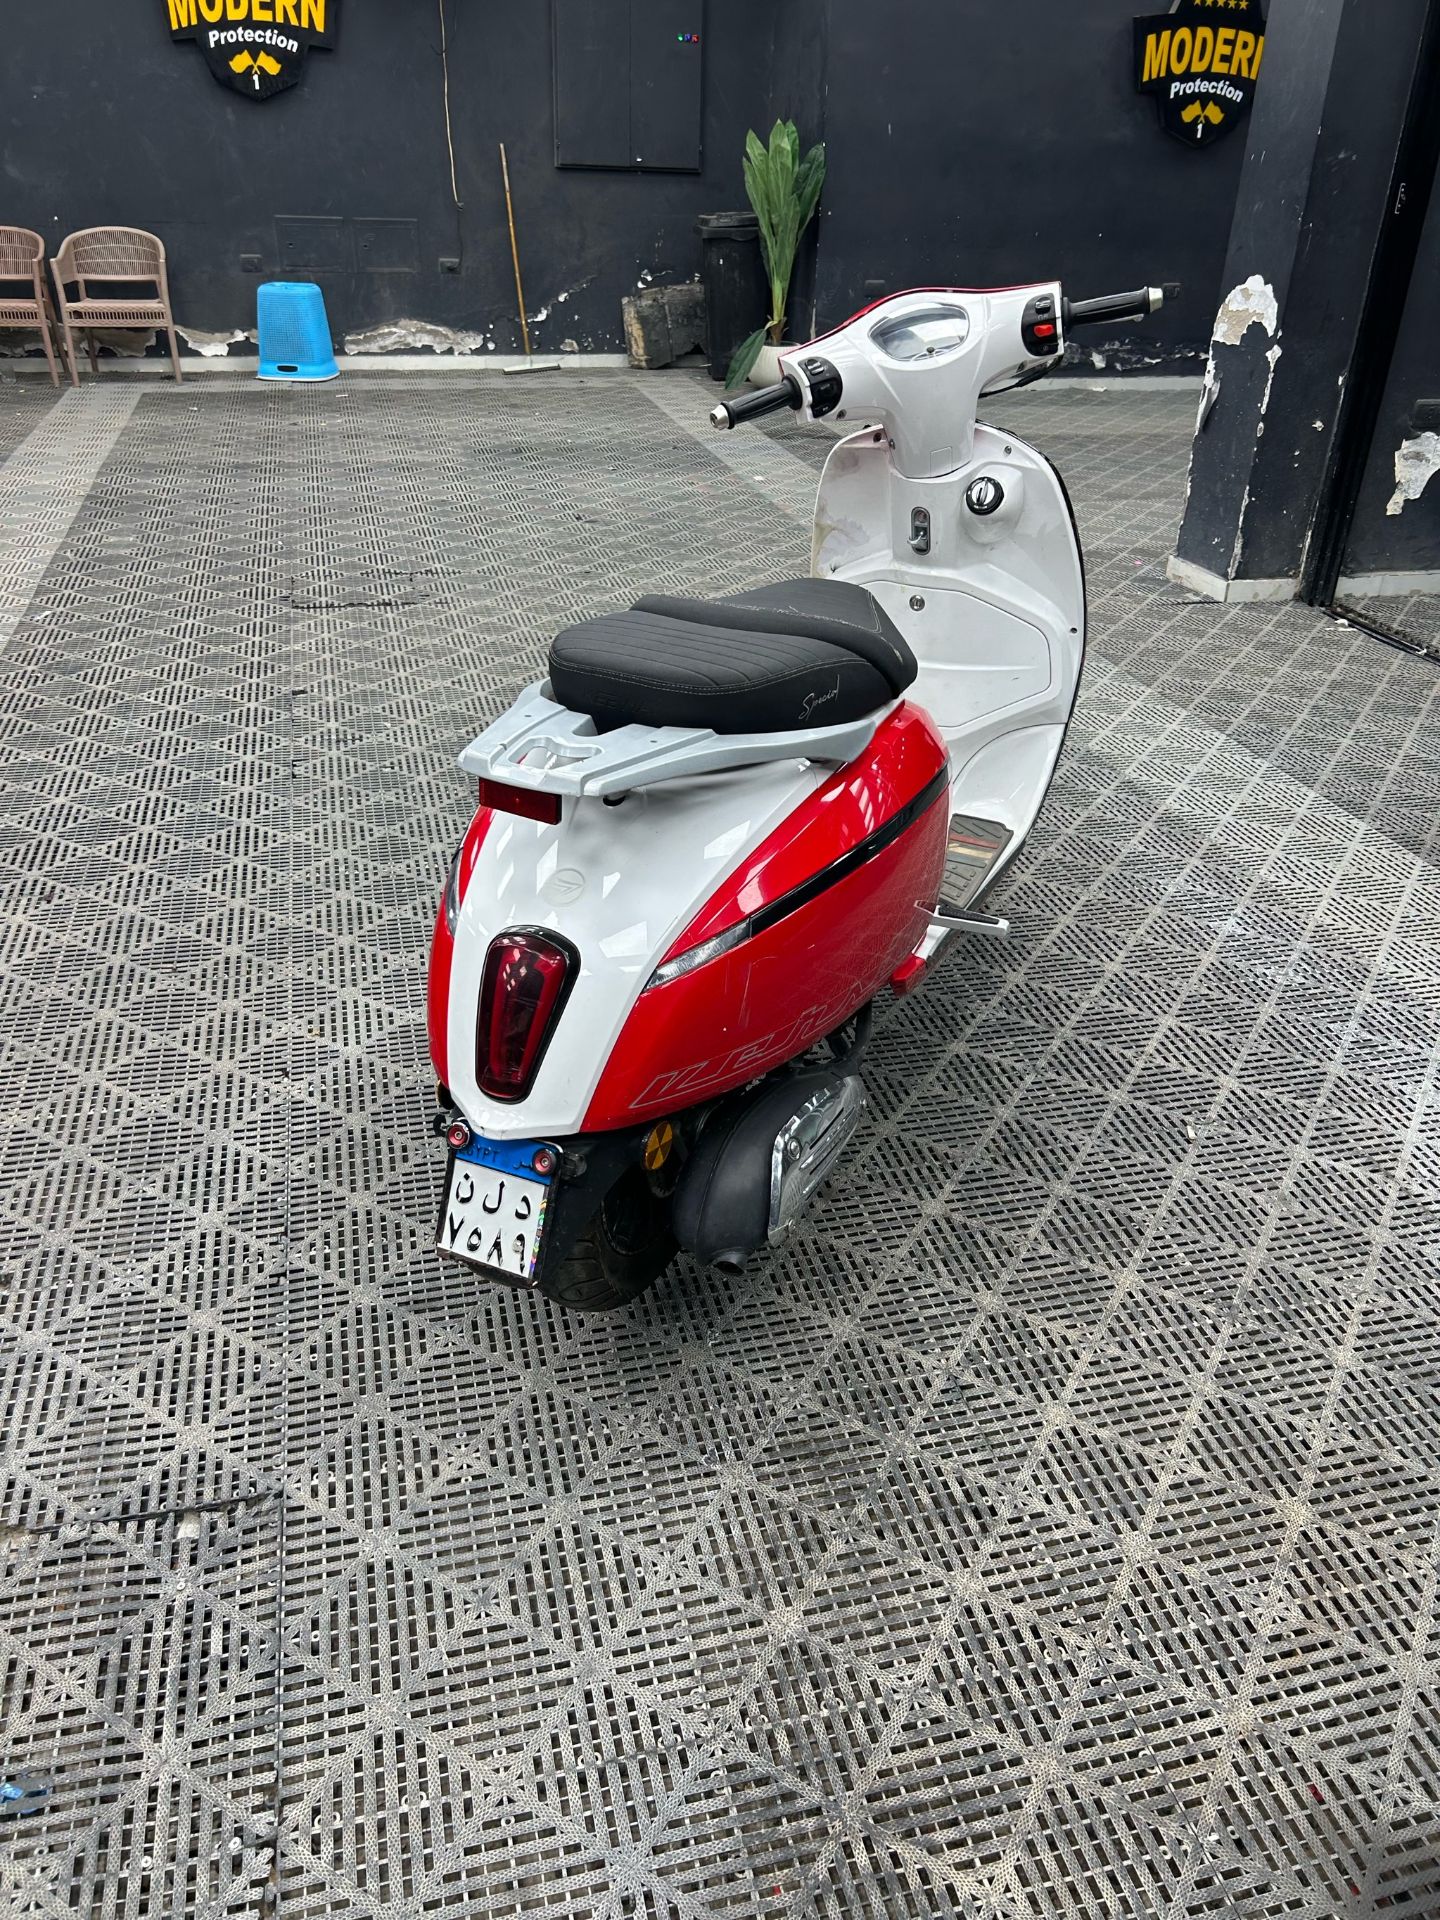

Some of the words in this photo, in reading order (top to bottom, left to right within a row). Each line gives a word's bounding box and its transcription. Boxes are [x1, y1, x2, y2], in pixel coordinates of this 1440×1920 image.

[208, 26, 299, 53] Protection
[252, 74, 260, 90] 1
[1169, 77, 1244, 103] Protection
[1196, 123, 1203, 139] 1
